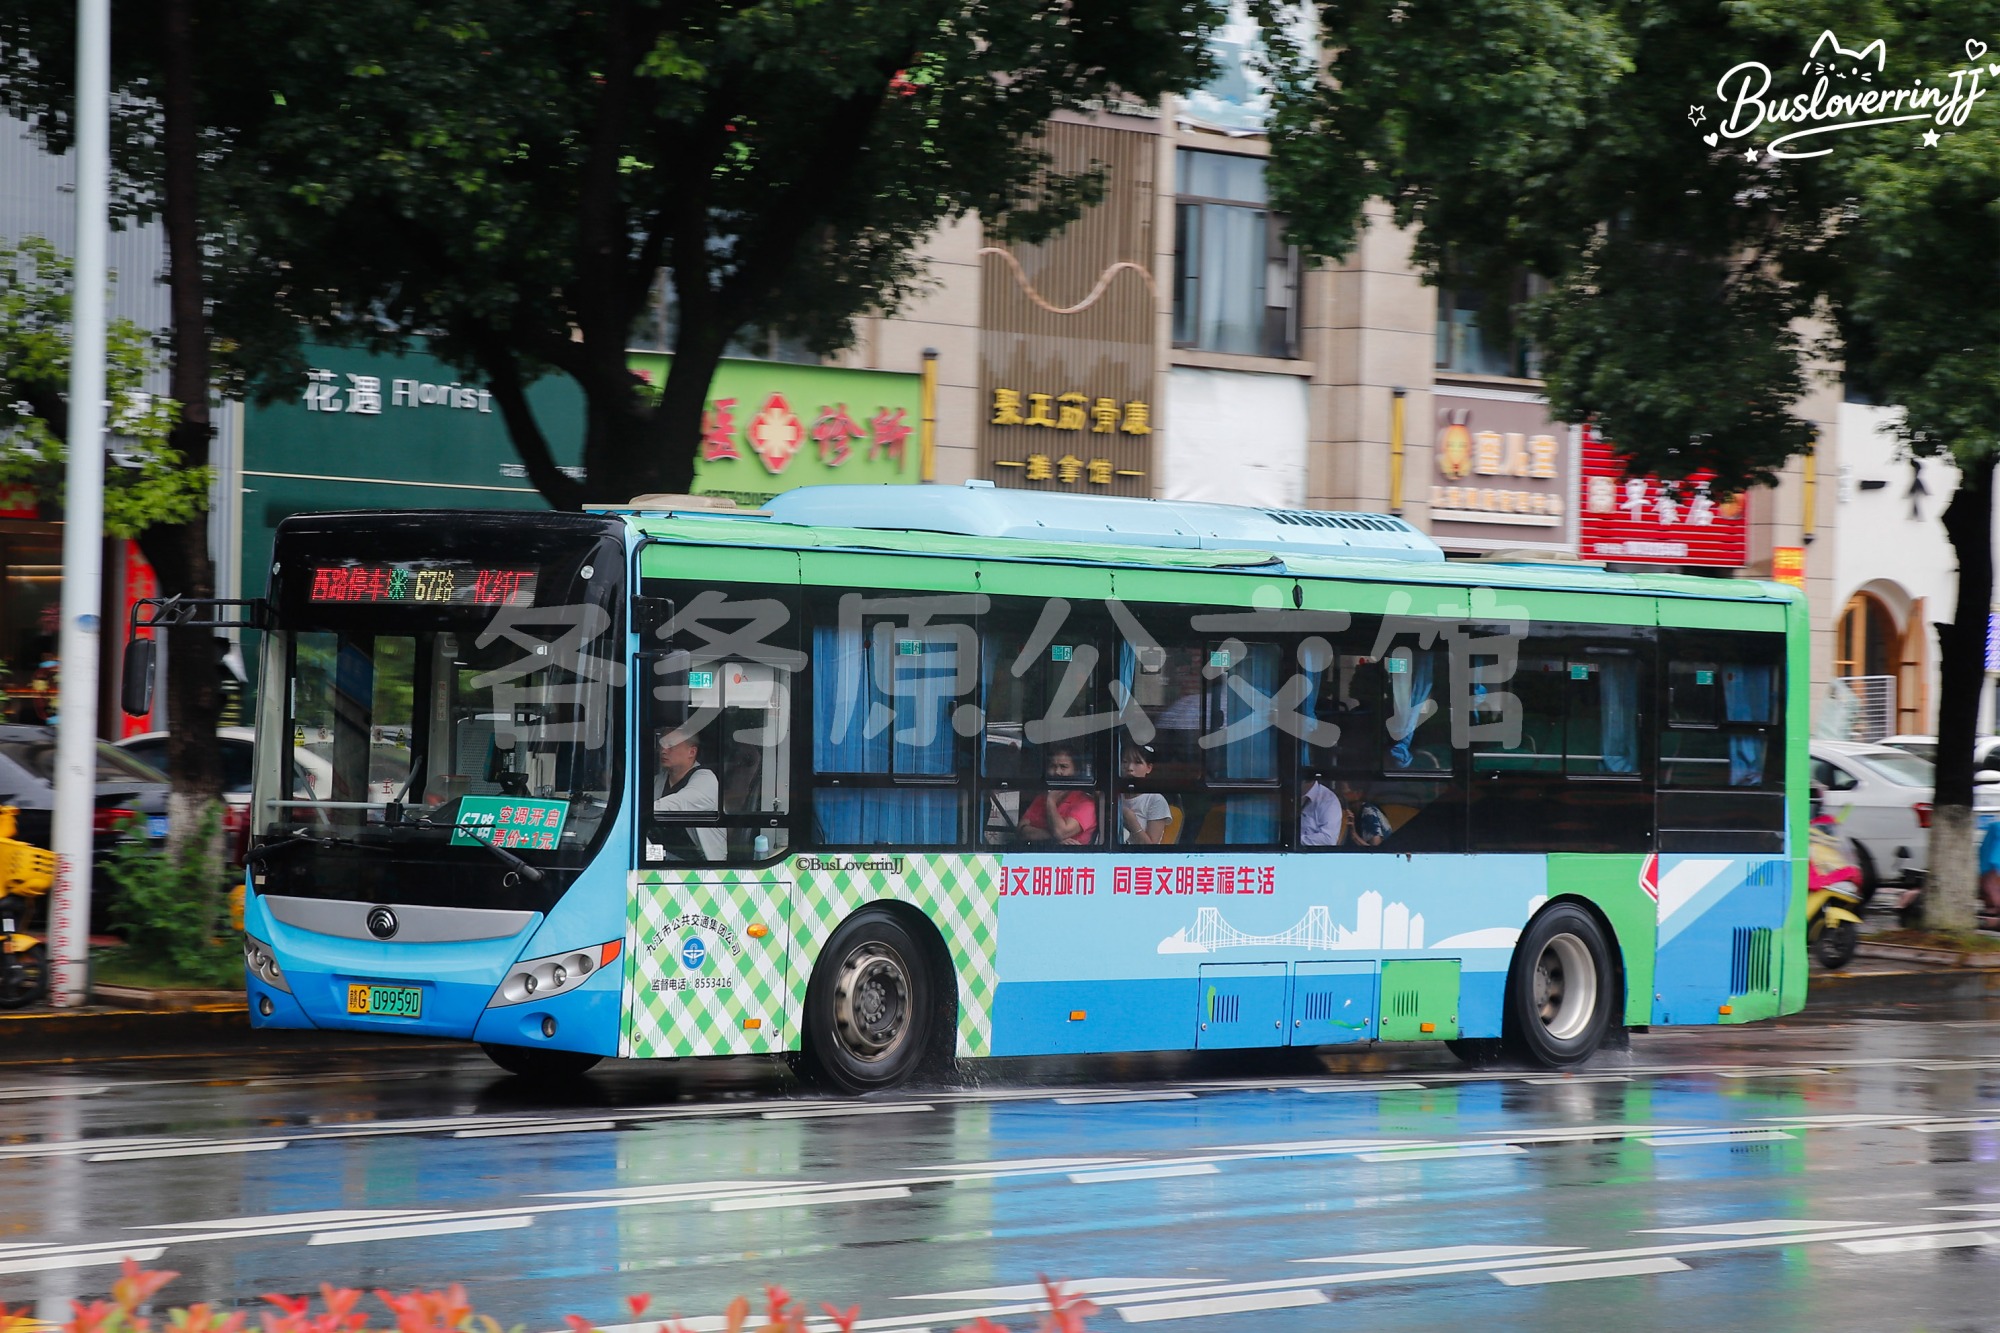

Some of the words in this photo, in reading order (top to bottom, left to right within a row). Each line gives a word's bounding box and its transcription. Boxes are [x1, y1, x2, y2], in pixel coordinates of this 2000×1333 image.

[302, 368, 382, 414] 花遇
[391, 378, 493, 413] Florist
[414, 570, 455, 602] 67路
[473, 570, 534, 604] 化纤厂
[498, 806, 561, 828] 空调开启
[491, 828, 554, 850] 票价+1元
[1113, 866, 1275, 896] 同享文明幸福生活
[646, 913, 741, 956] 九江市公共交通集团公司
